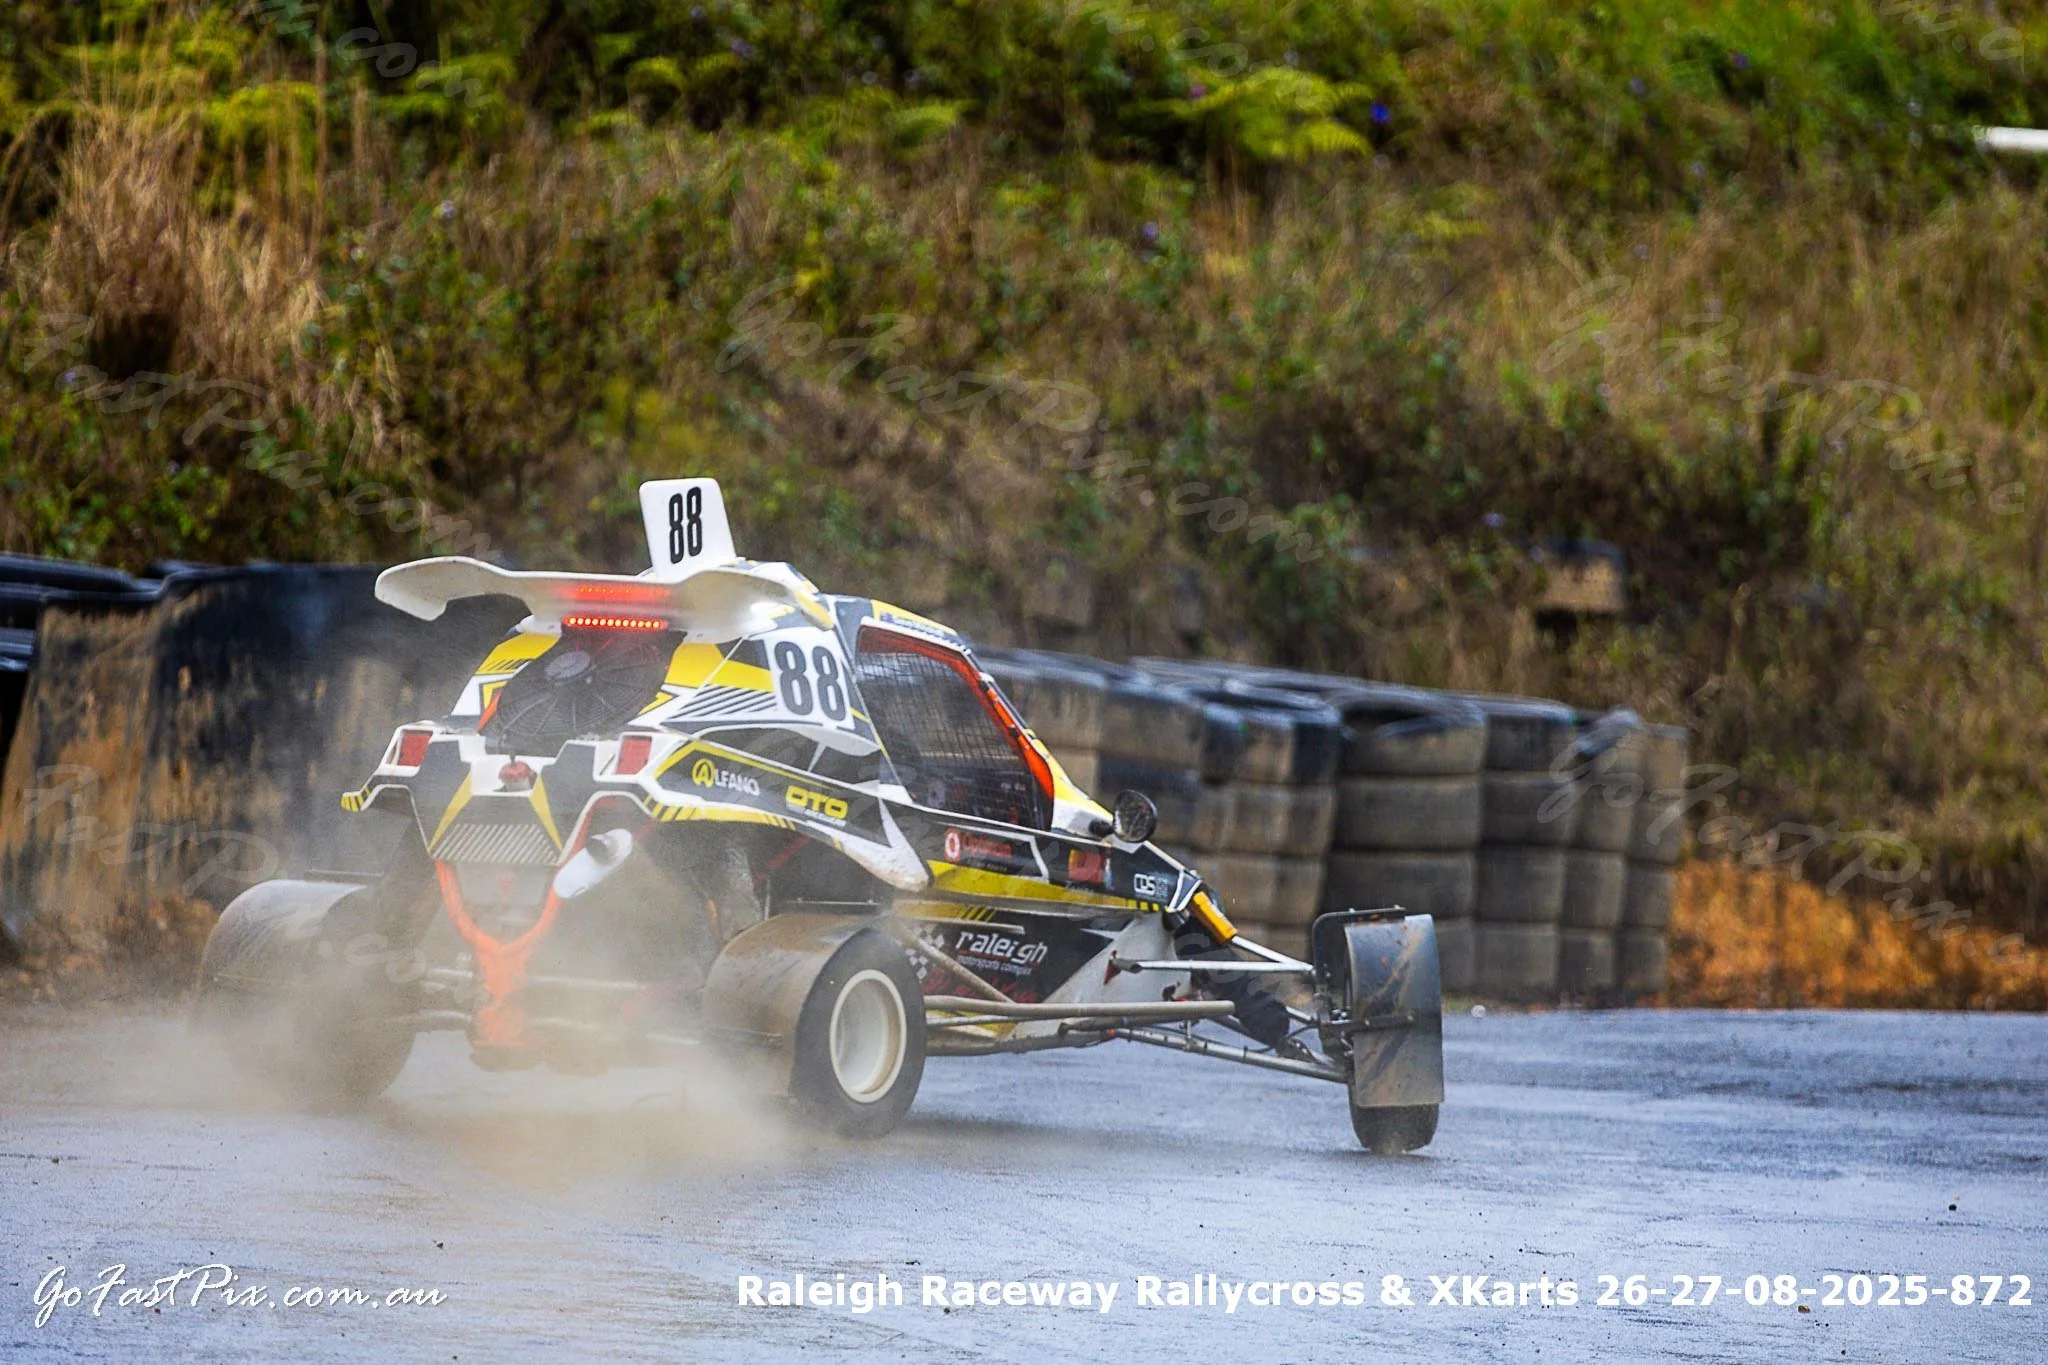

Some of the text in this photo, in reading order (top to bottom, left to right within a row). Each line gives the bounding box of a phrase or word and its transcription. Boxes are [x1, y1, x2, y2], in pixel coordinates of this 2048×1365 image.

[669, 487, 702, 564] 88
[775, 641, 846, 721] 88
[692, 758, 760, 796] ALFANO
[786, 785, 848, 819] OTO
[955, 931, 1049, 965] raleigh
